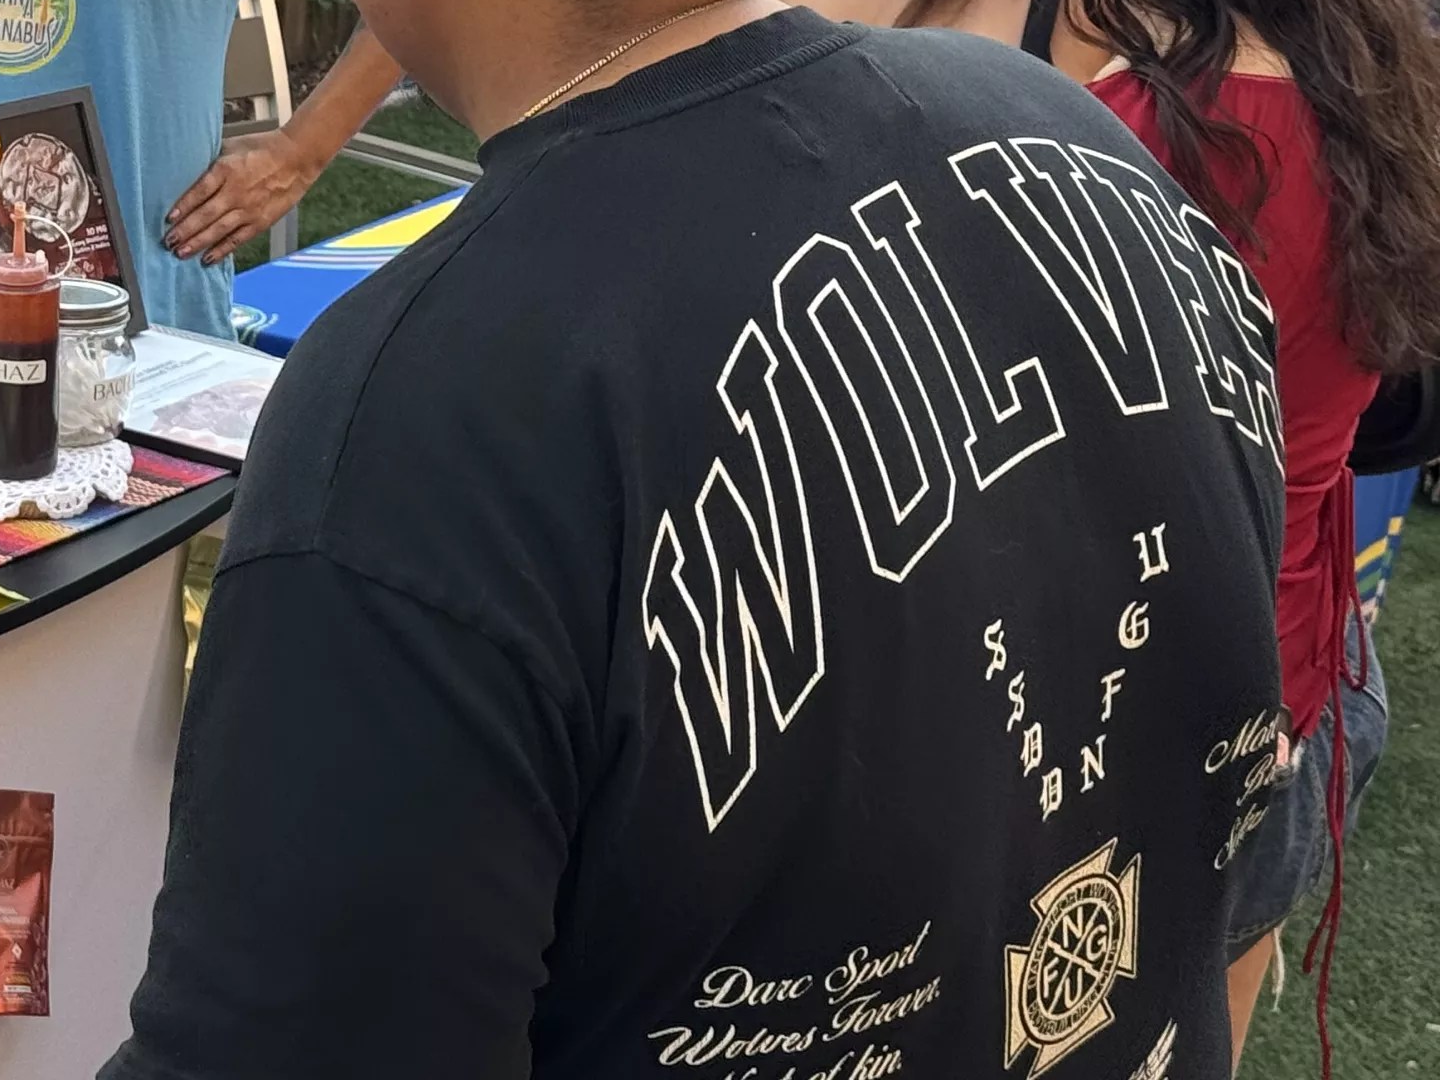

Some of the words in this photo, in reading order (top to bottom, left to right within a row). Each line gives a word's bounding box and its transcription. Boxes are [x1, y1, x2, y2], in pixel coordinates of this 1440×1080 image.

[694, 966, 813, 1008] Darc
[825, 920, 931, 1004] Sport
[648, 1024, 817, 1066] Wolves
